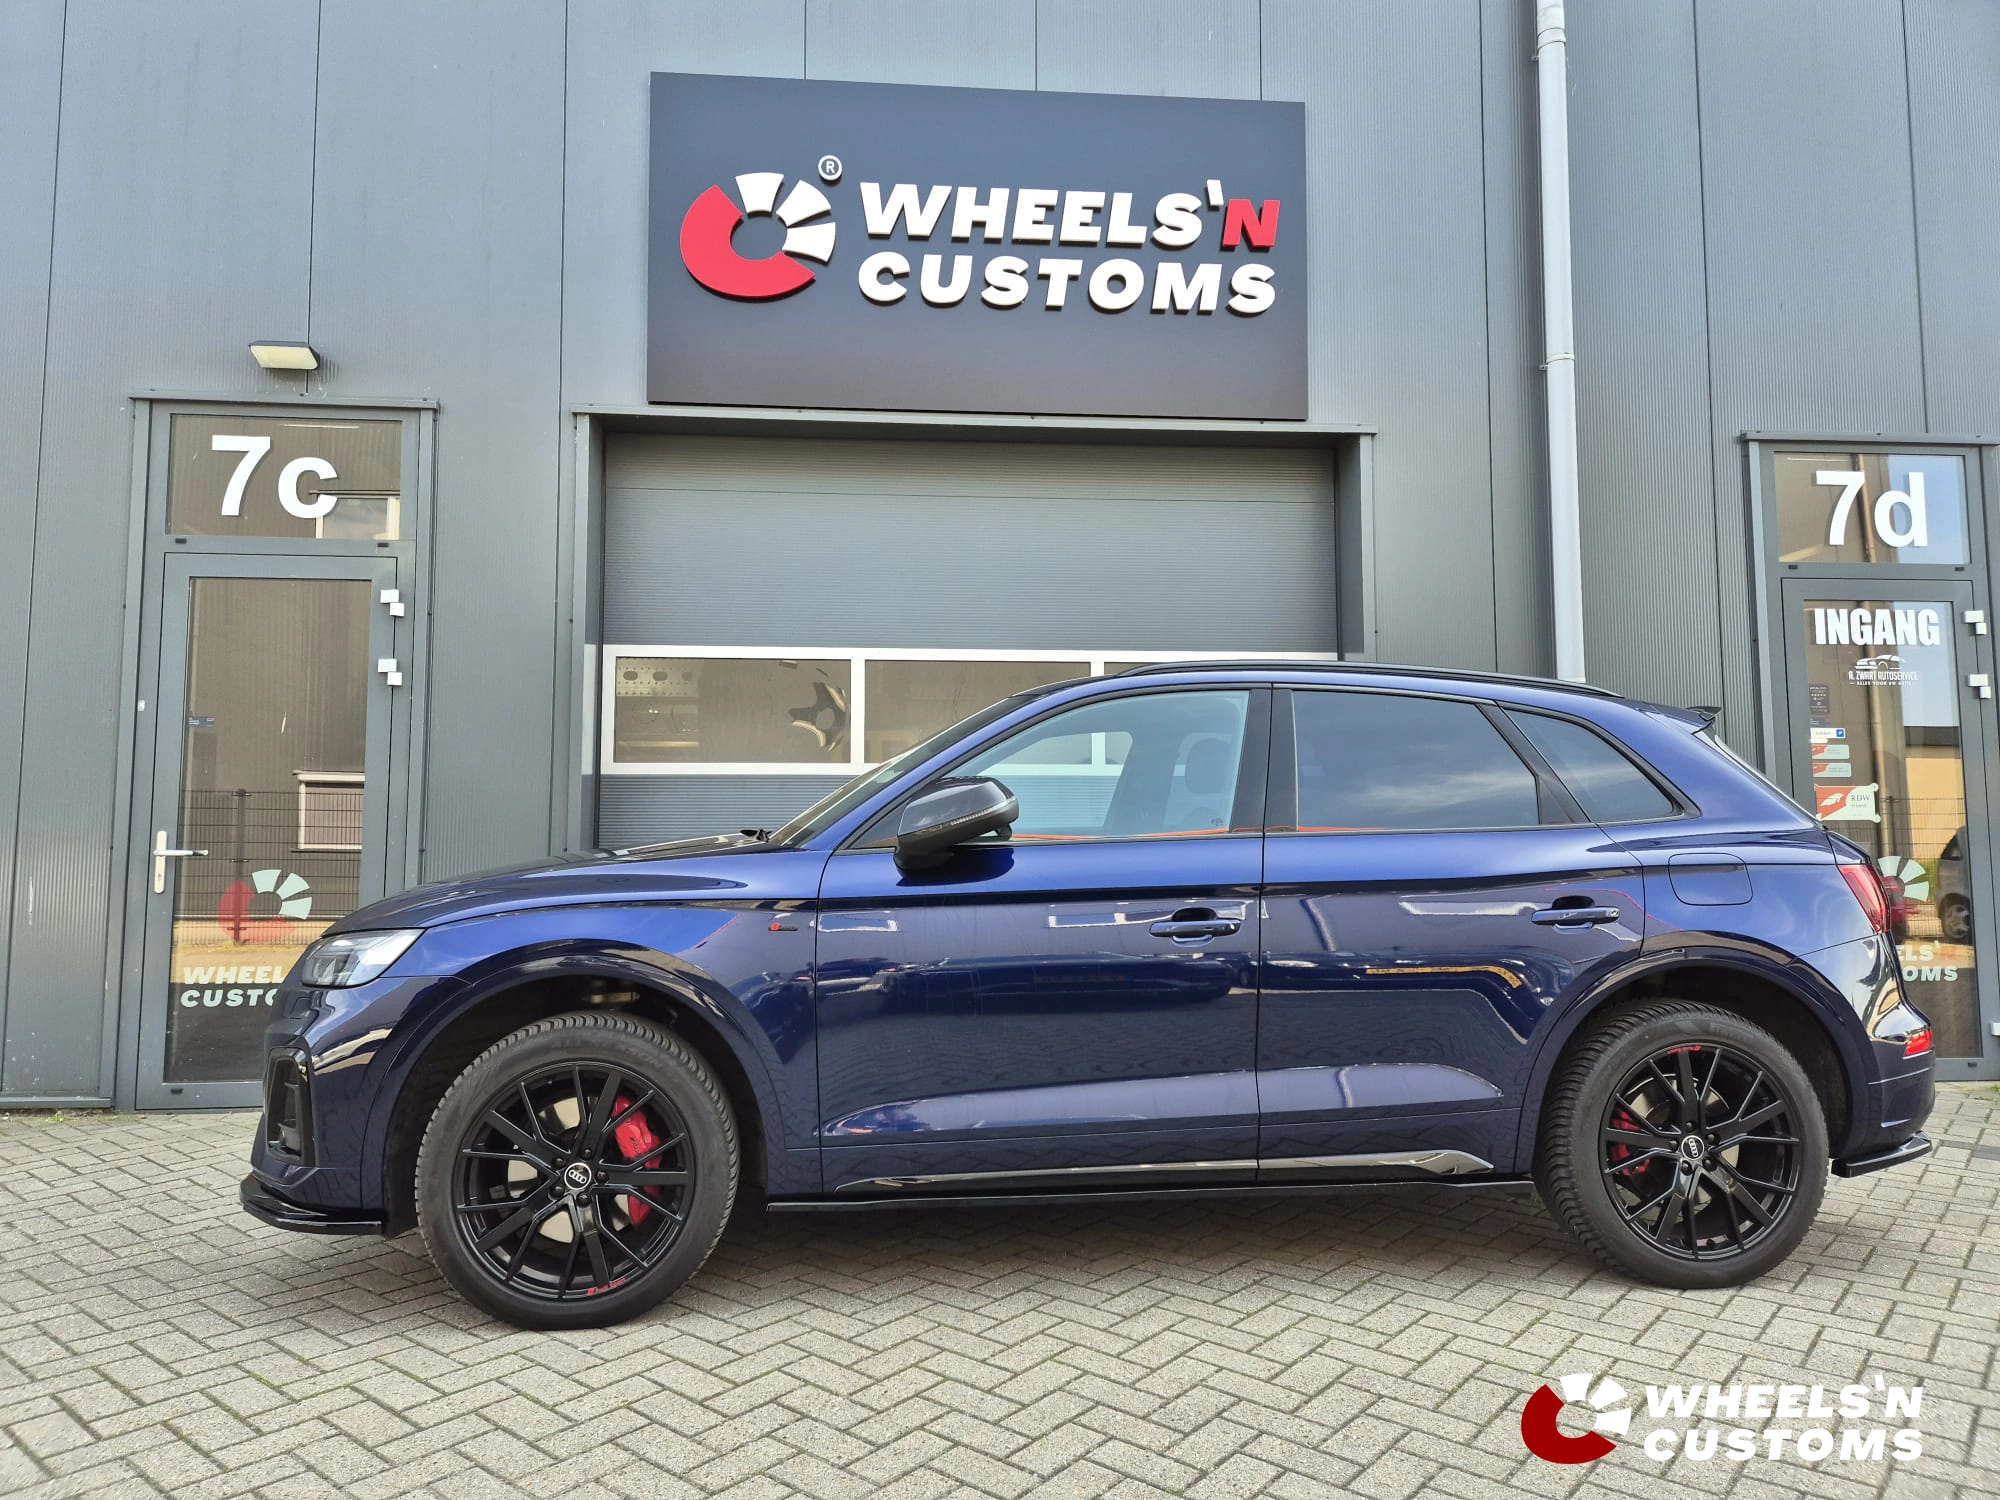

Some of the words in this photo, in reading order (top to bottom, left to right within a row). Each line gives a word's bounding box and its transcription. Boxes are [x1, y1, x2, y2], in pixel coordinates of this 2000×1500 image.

[858, 251, 1277, 315] CUSTOMS
[211, 434, 338, 519] 7c
[1816, 470, 1929, 548] 7d
[1814, 607, 1941, 647] INGANG
[1878, 671, 1918, 681] AUTOSERVICE
